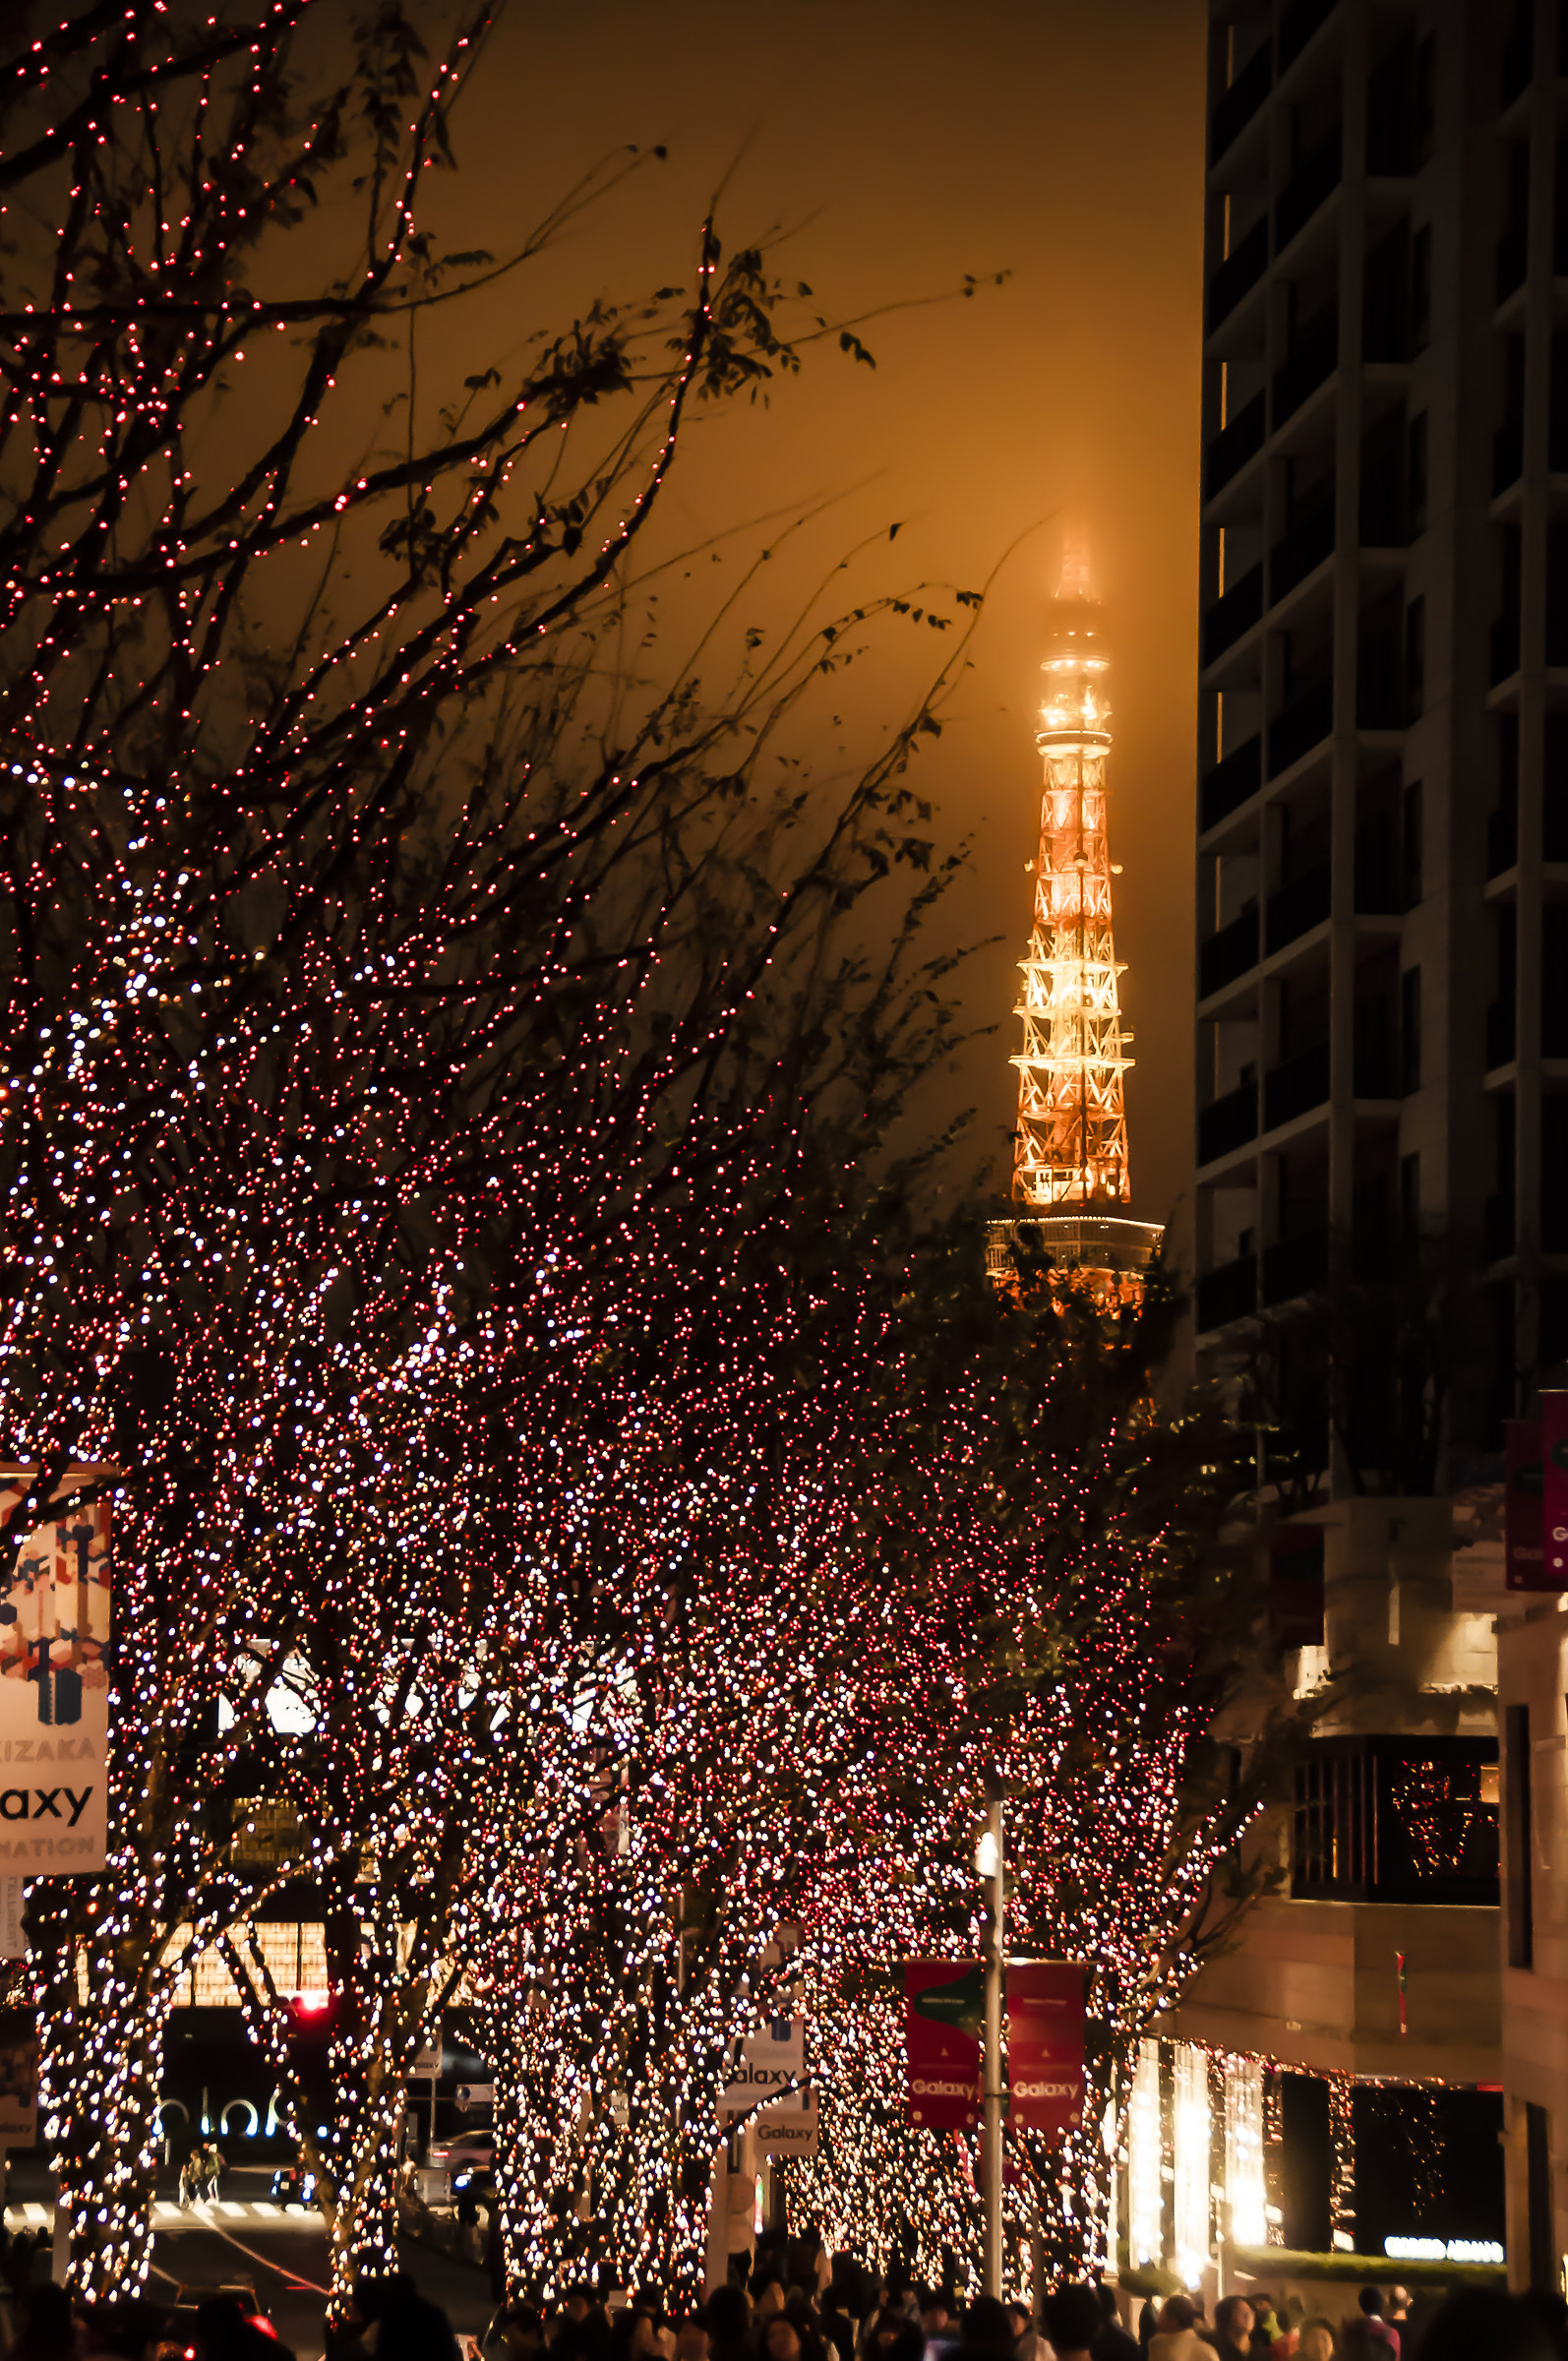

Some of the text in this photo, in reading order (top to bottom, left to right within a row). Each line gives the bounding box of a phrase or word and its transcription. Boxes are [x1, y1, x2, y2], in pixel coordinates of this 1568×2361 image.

[0, 1737, 96, 1762] IZAKA
[0, 1786, 93, 1827] axy
[734, 2062, 796, 2086] alaxy
[912, 2079, 976, 2100] Galaxy
[1013, 2081, 1079, 2099] Galaxy
[757, 2124, 813, 2141] Galaxy
